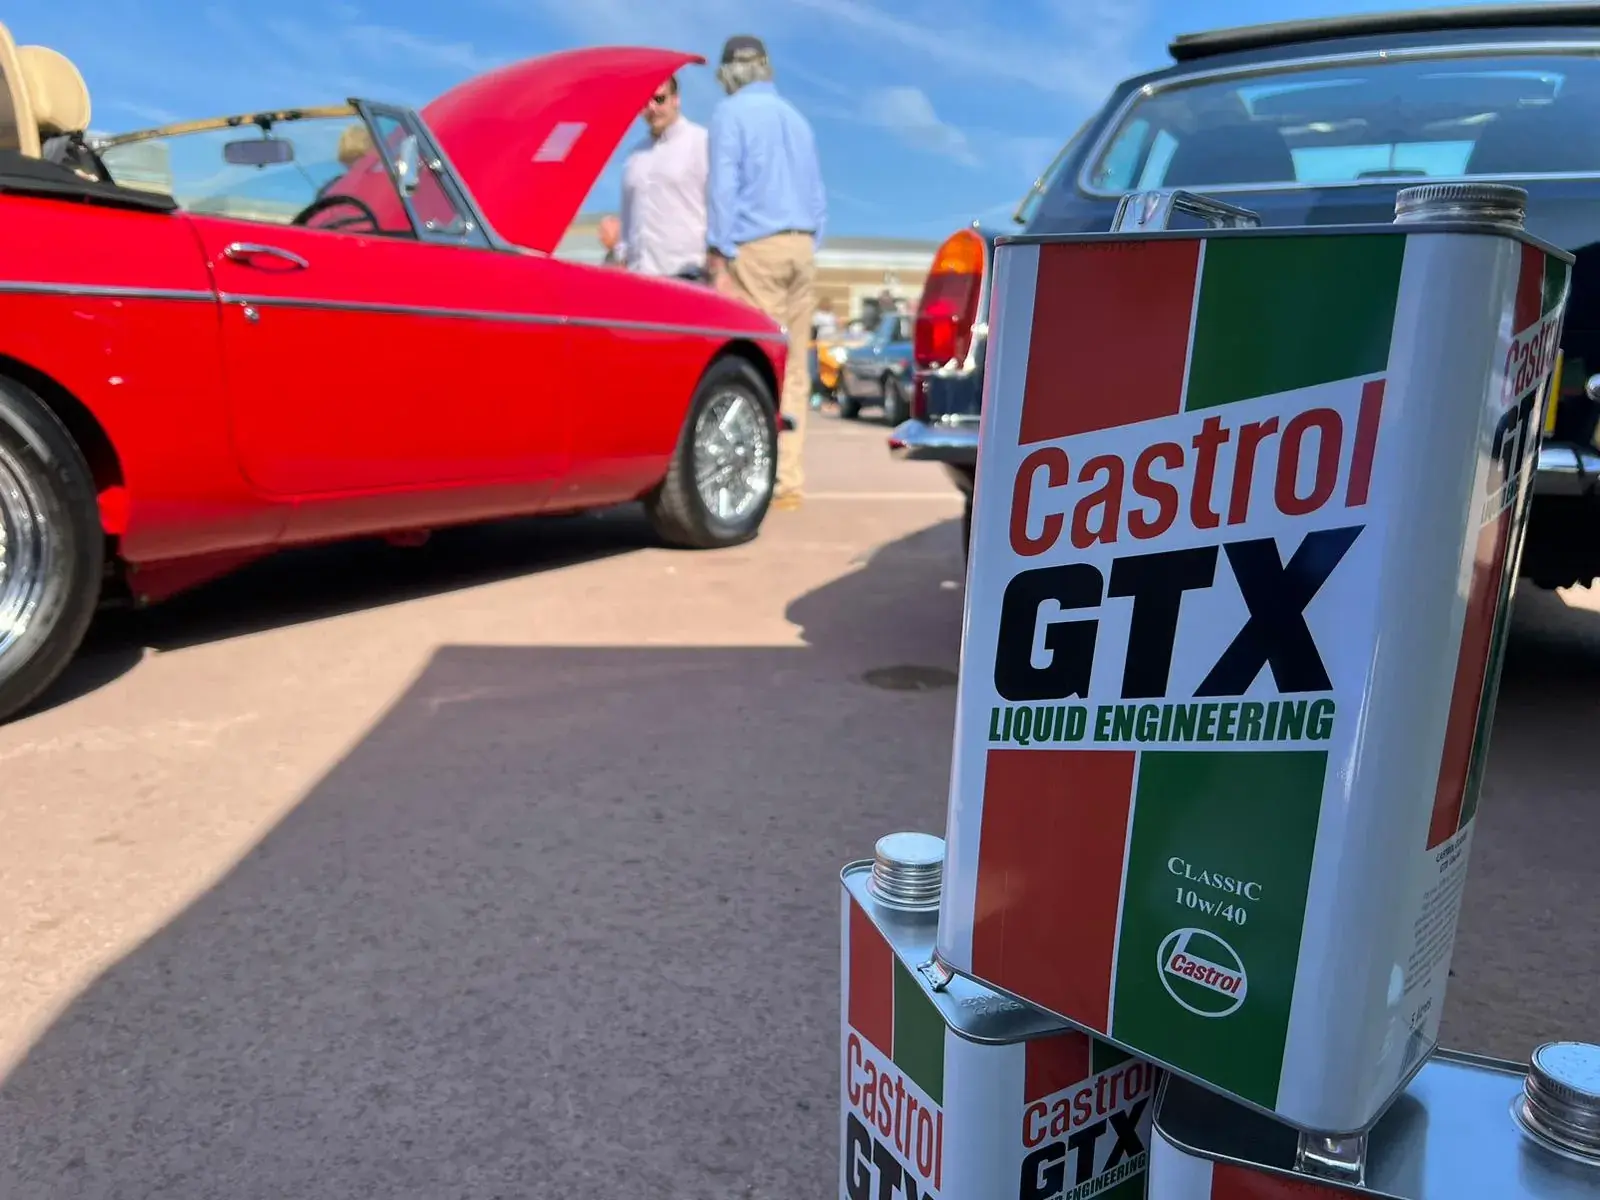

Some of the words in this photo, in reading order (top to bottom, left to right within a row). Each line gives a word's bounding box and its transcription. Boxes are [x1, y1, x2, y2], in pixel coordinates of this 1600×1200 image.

[1009, 379, 1386, 557] Castrol
[994, 524, 1366, 701] GTX
[988, 704, 1087, 745] LIQUID
[1094, 699, 1336, 742] ENGINEERING
[1167, 856, 1262, 901] CLASSIC
[1176, 887, 1247, 926] 10w/40
[1170, 954, 1242, 994] Castrol
[847, 1032, 943, 1192] Castrol
[1020, 1096, 1150, 1200] GTX
[1022, 1062, 1152, 1148] Castrol
